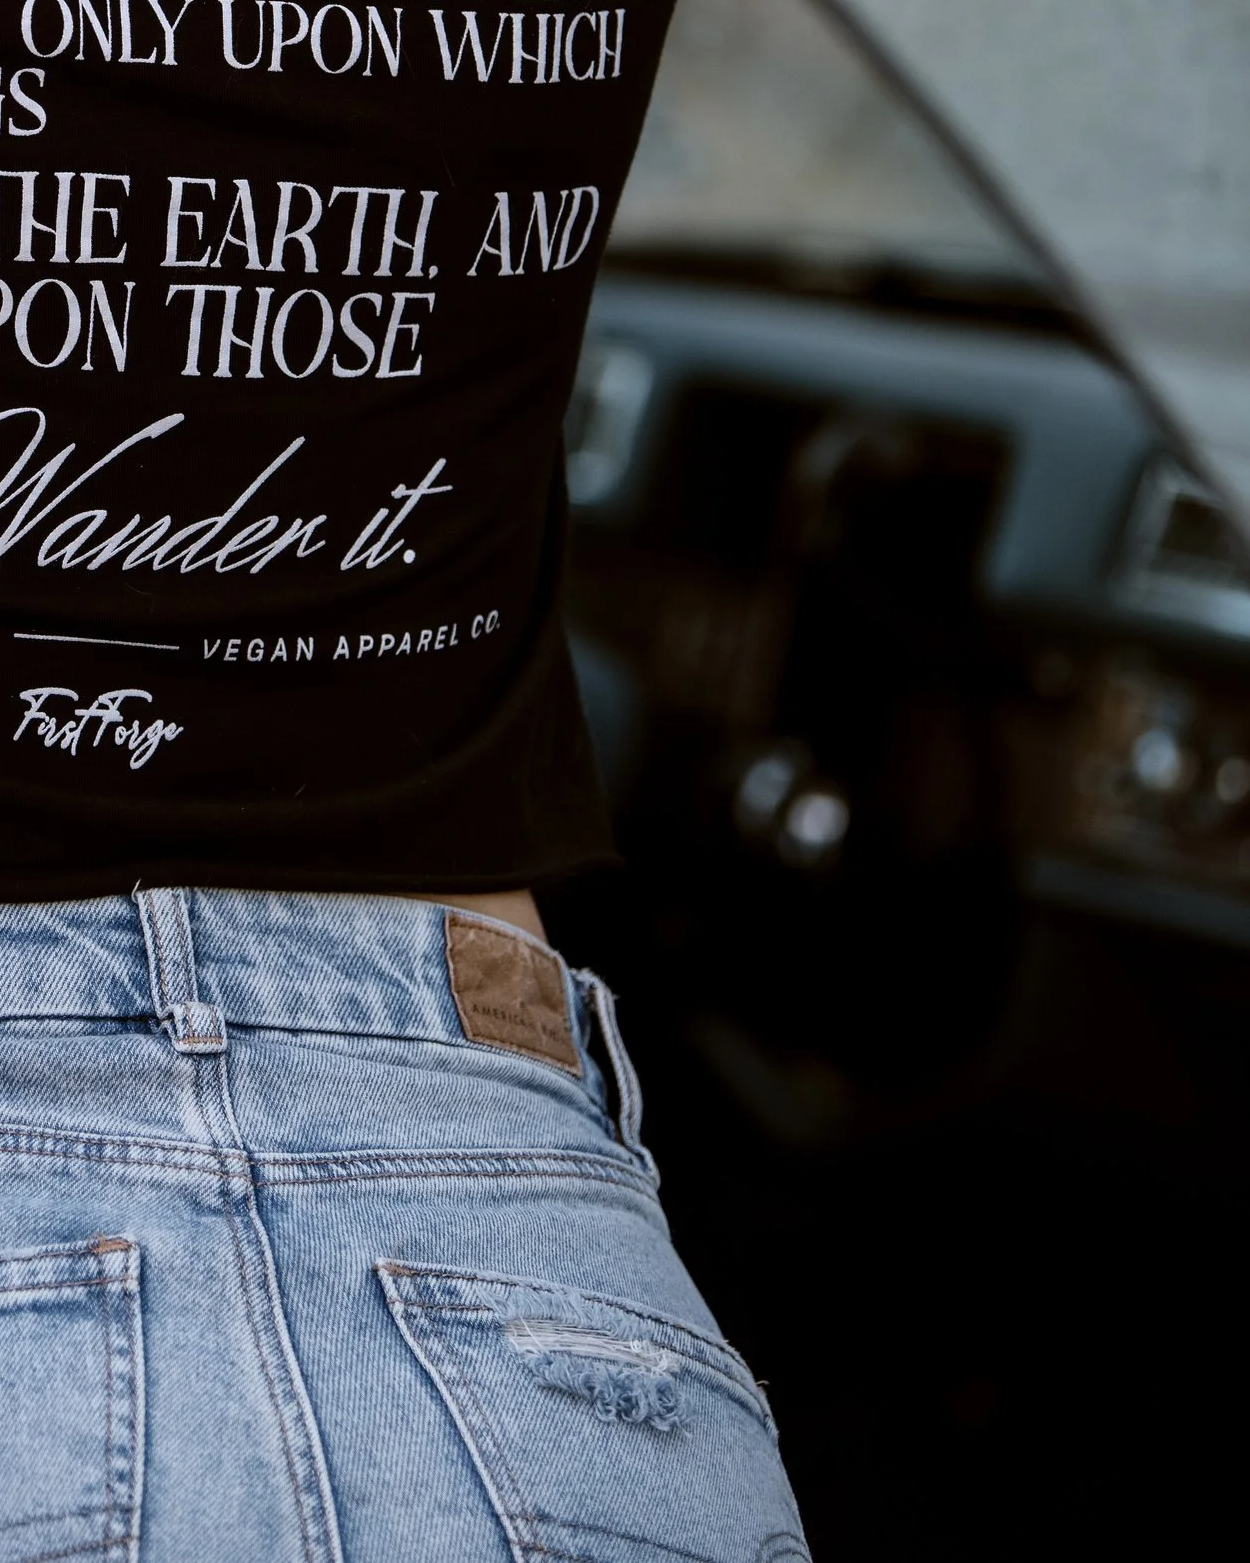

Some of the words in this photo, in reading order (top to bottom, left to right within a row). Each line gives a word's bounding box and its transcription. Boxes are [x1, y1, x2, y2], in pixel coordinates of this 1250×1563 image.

[218, 0, 403, 77] UPON
[428, 9, 625, 83] WHICH
[160, 177, 439, 279] EARTH,
[467, 186, 599, 276] AND
[166, 285, 435, 378] THOSE
[341, 458, 453, 570] it.
[204, 637, 313, 662] VEGAN
[333, 624, 458, 659] APPAREL
[471, 610, 500, 639] CO.
[472, 1004, 536, 1029] AMERICA
